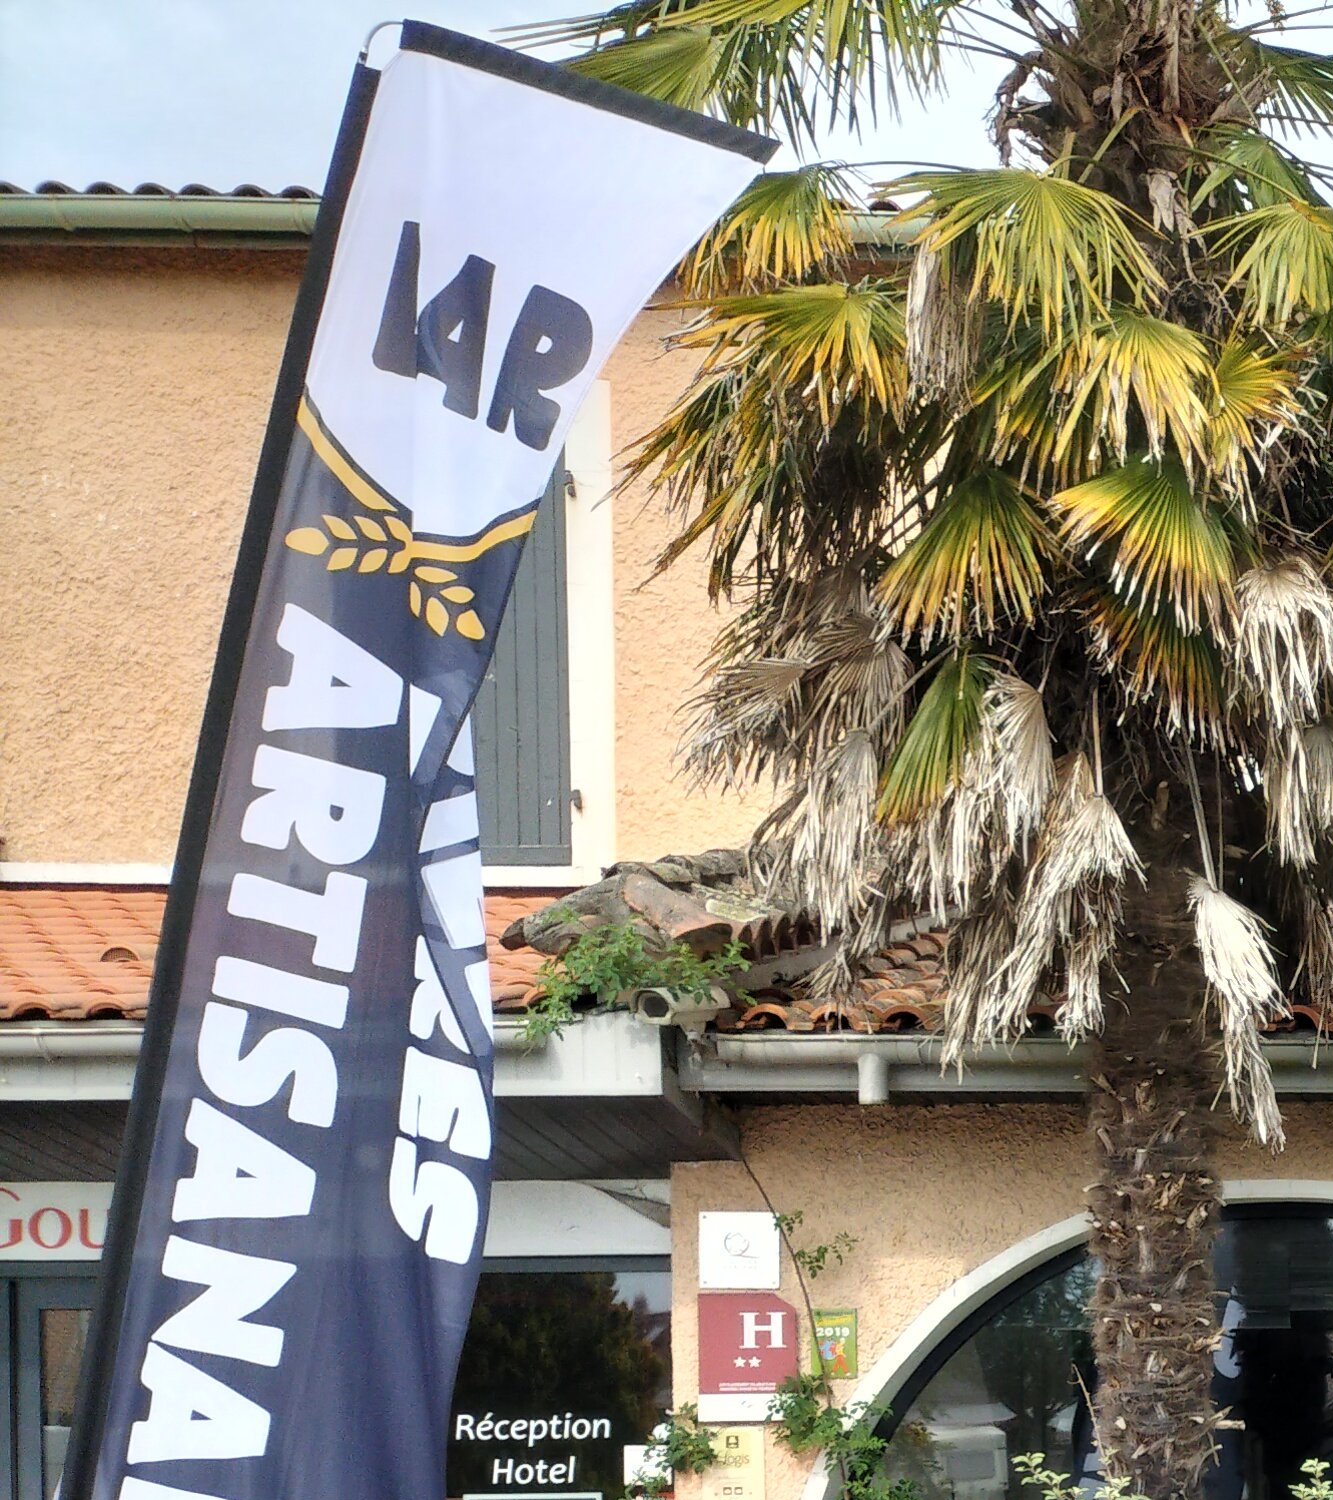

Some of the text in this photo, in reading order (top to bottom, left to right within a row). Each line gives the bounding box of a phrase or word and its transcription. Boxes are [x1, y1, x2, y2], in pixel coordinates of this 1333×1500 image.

[739, 1312, 787, 1349] H
[816, 1326, 850, 1337] 2019
[455, 1412, 611, 1447] Réception
[492, 1455, 576, 1485] Hotel
